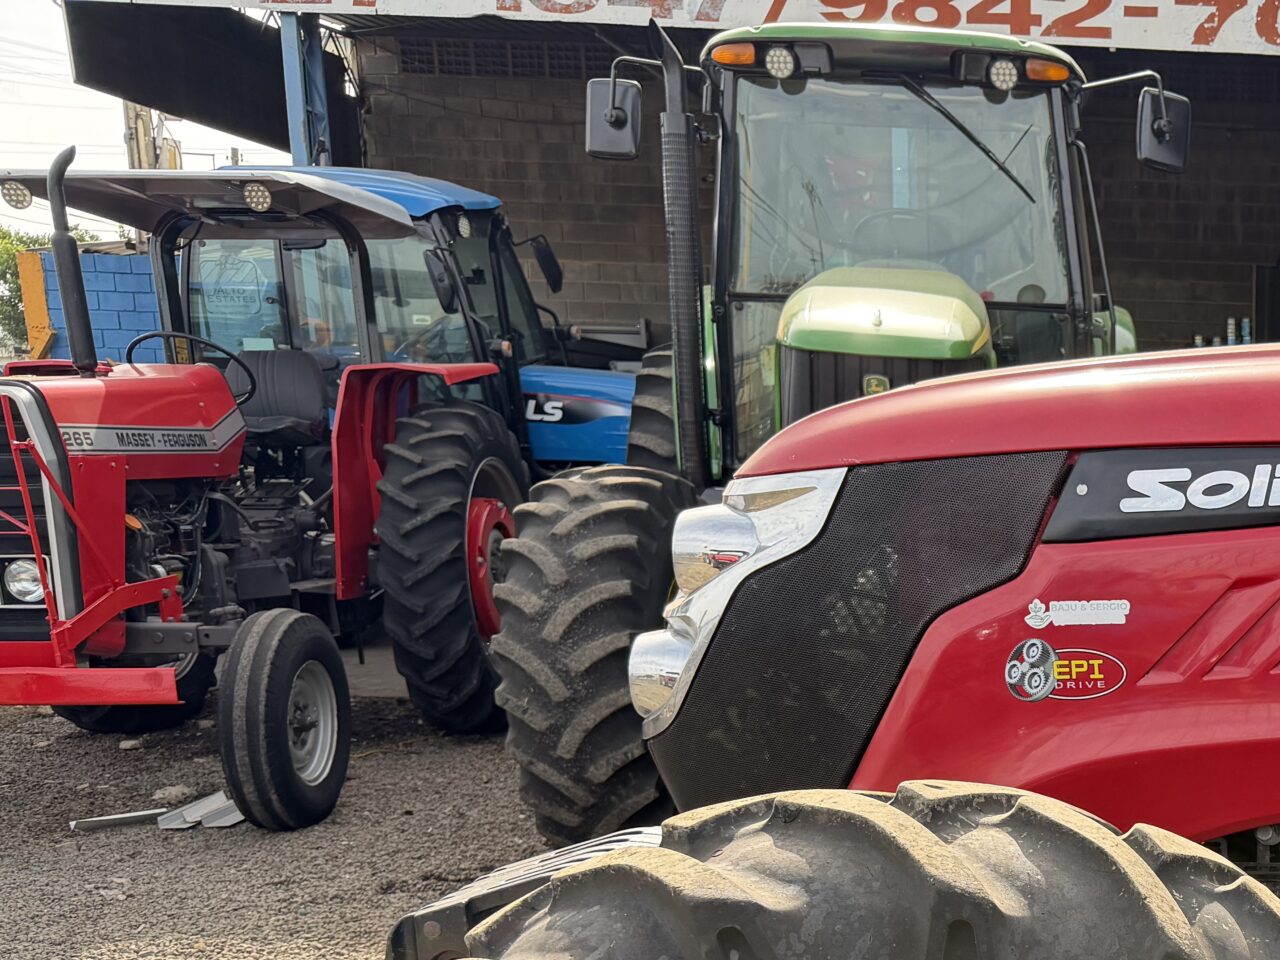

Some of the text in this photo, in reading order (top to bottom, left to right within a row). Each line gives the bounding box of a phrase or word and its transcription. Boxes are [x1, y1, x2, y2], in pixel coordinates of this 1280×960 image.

[525, 399, 564, 422] LS
[62, 431, 94, 447] 265
[1051, 602, 1128, 612] BAJU & SERGIO
[1053, 659, 1105, 680] EPI
[1055, 680, 1106, 690] DRIVE
